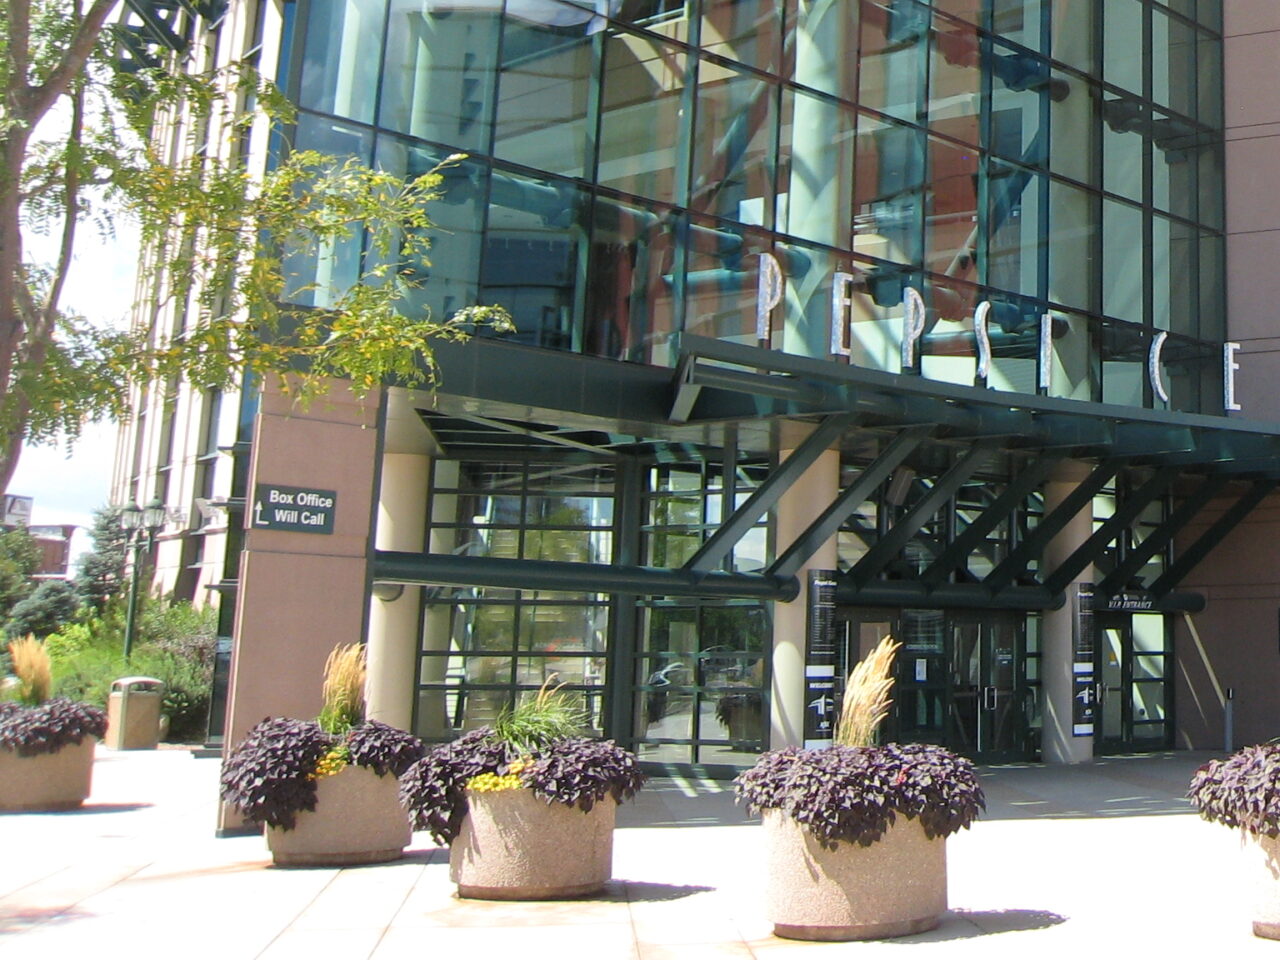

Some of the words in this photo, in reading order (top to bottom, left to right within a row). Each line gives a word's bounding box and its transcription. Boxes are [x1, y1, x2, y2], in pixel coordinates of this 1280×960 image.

[756, 252, 1052, 388] PEPSI
[269, 490, 294, 504] Box
[296, 493, 333, 508] Office
[274, 509, 298, 523] Will
[301, 512, 325, 525] Call
